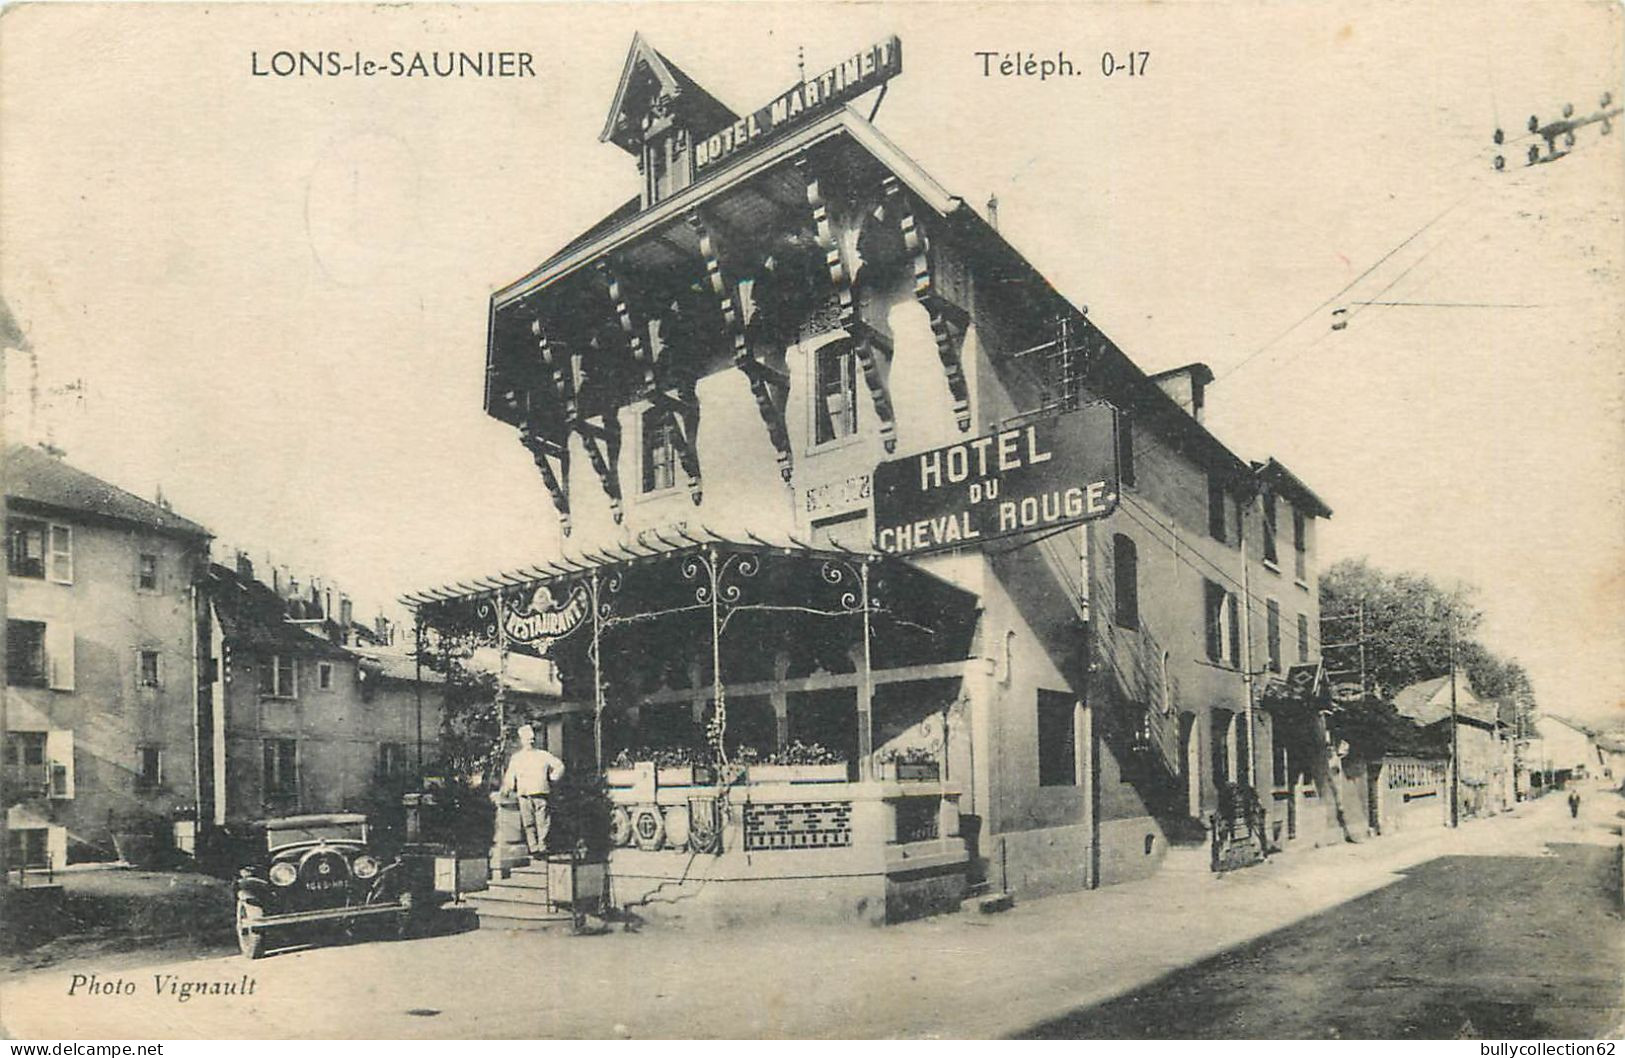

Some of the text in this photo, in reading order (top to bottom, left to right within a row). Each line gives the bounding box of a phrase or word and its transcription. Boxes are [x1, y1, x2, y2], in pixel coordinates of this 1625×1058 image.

[696, 39, 894, 171] HOTEL MARTINET
[920, 425, 1052, 491] HOTEL
[969, 478, 999, 504] DU
[879, 511, 980, 553] CHEVAL
[506, 600, 582, 640] RESTAURANT
